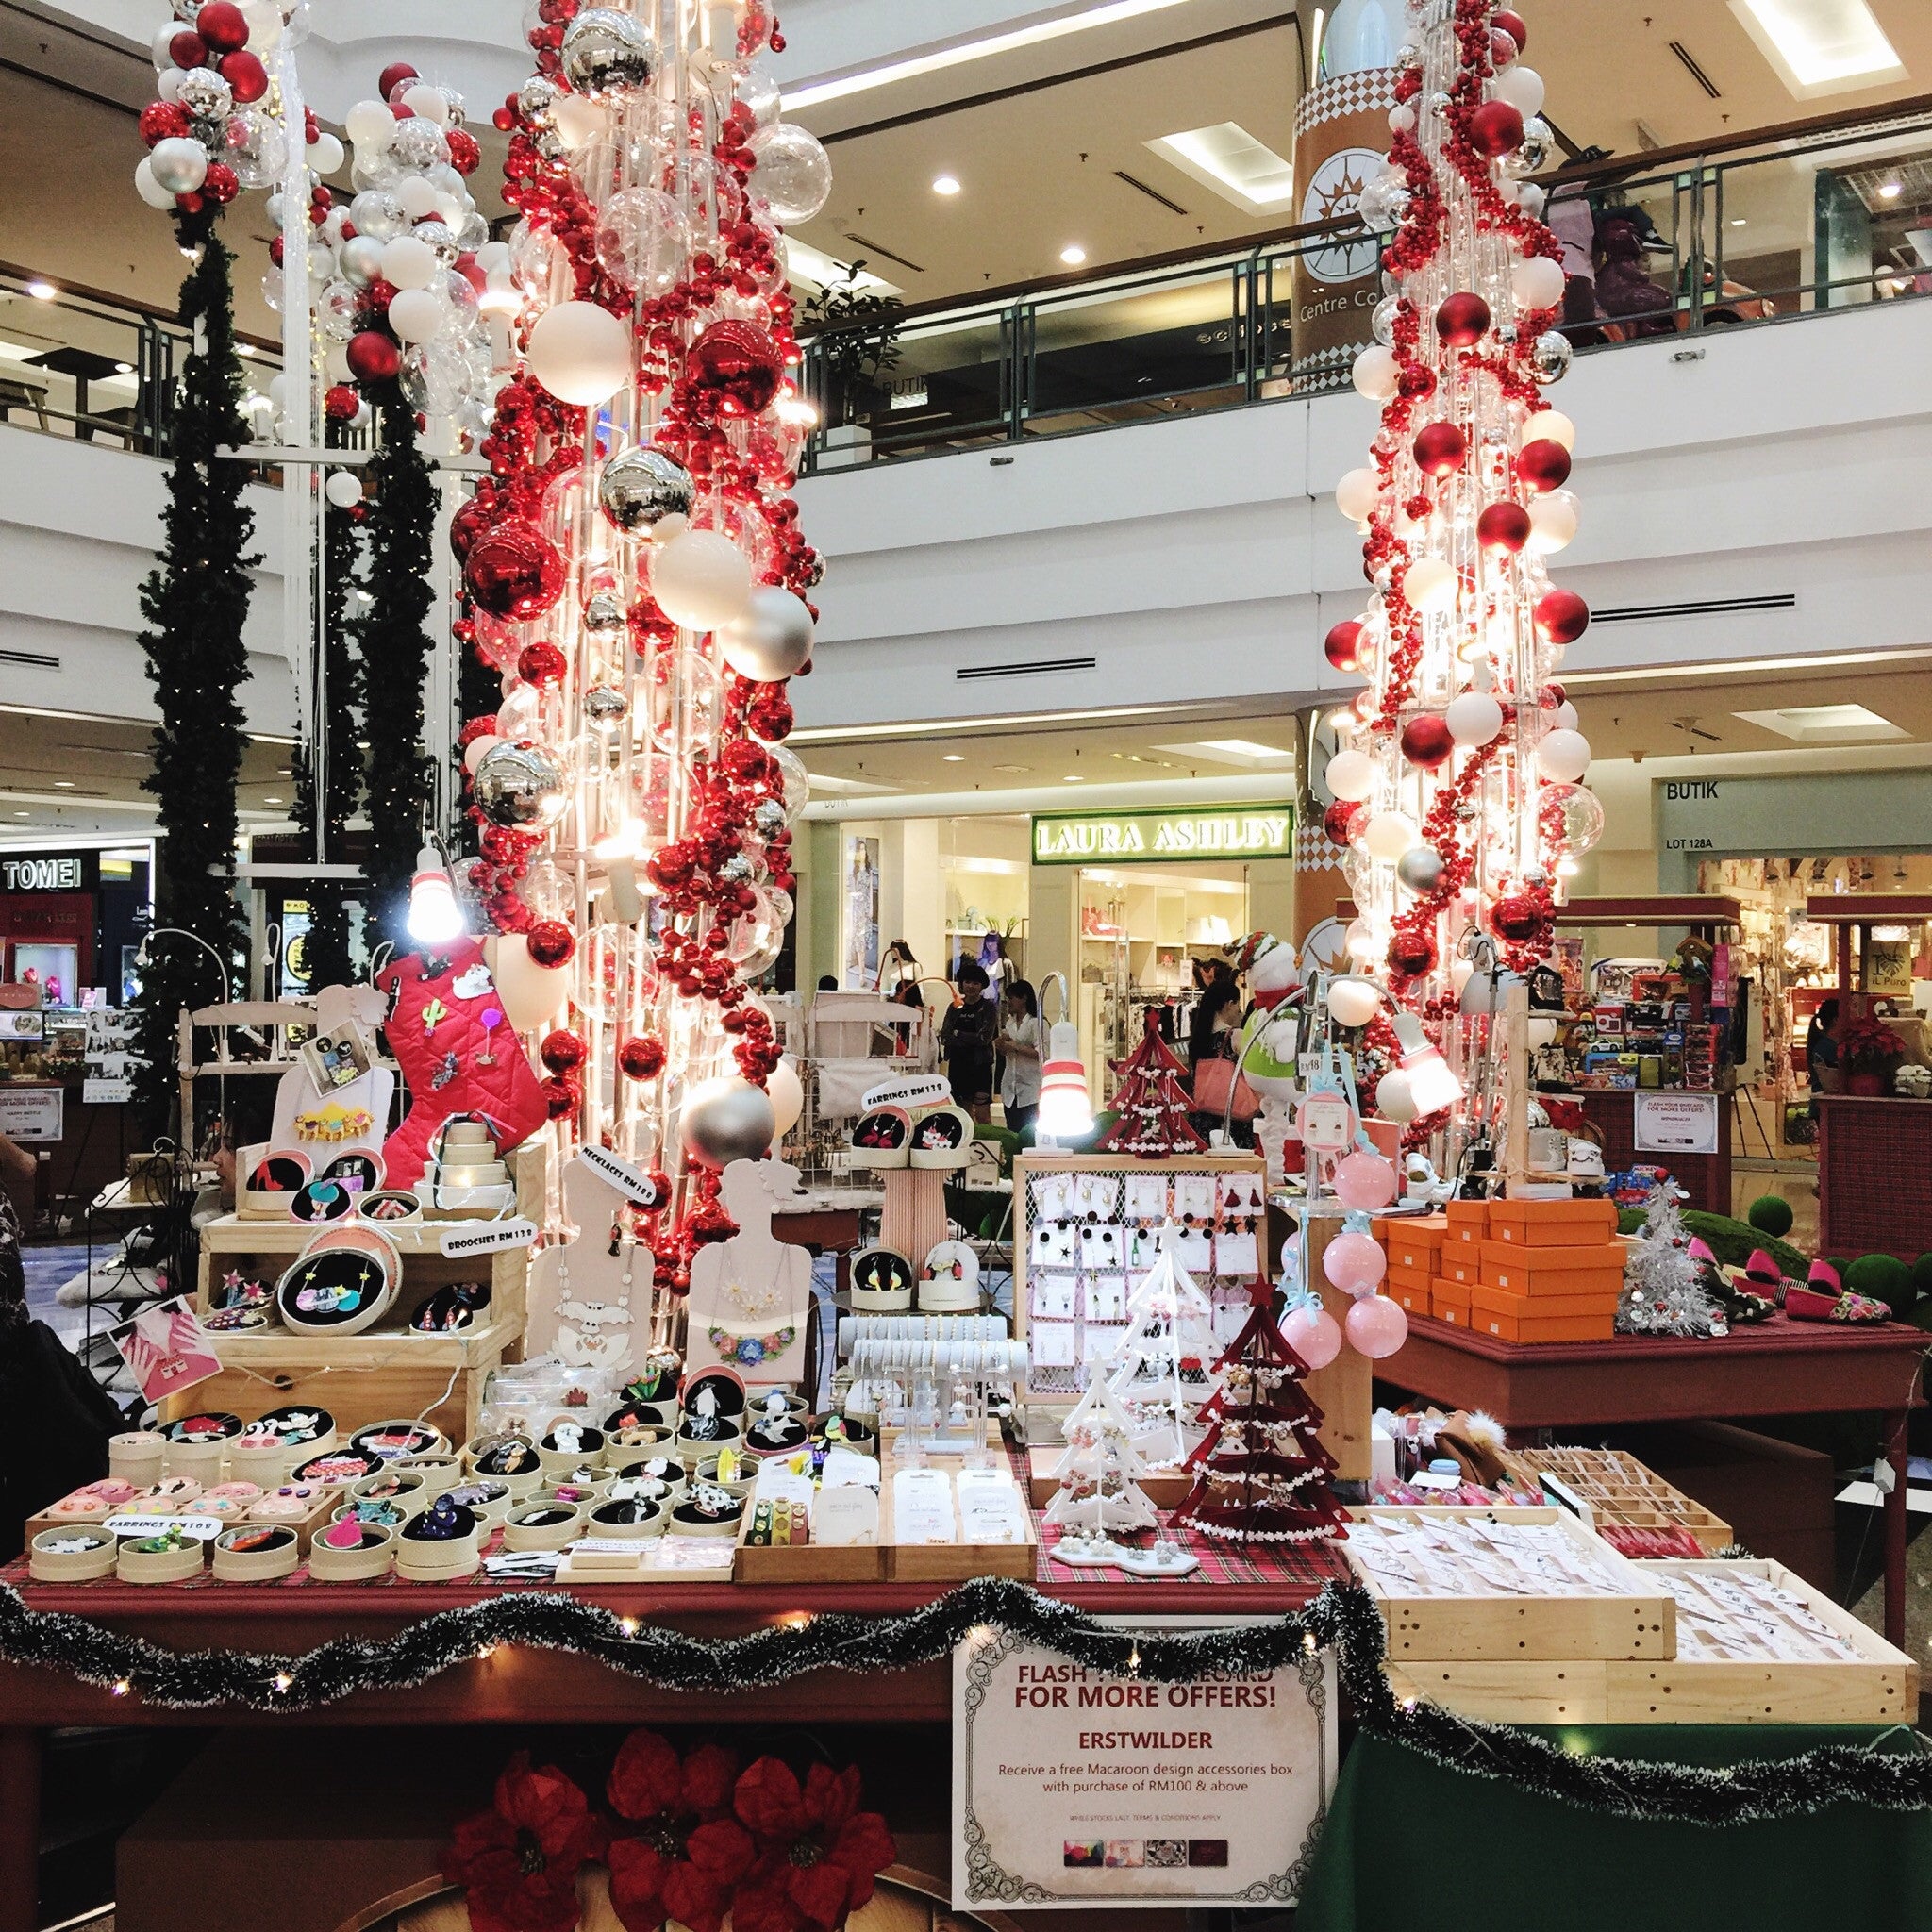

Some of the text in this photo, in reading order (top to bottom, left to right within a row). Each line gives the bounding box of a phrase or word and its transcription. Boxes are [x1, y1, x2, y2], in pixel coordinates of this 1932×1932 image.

[1301, 290, 1377, 323] Centre Co
[1667, 781, 1719, 800] BUTIK
[1037, 817, 1289, 855] LAURA ASHLEY
[1667, 839, 1713, 849] LOT 128A
[2, 859, 82, 889] TOMEI
[867, 1090, 908, 1106] EARRINGS
[583, 1147, 624, 1178] NECKLACES
[448, 1235, 495, 1250] BROOCHES
[1018, 1665, 1086, 1683] FLASH
[1015, 1685, 1276, 1708] FOR MORE OFFERS!
[1078, 1731, 1213, 1750] ERSTWILDER
[998, 1763, 1293, 1778] Receive a free Macaroon design accessories box
[1042, 1779, 1249, 1794] with purchase of RM100 & above
